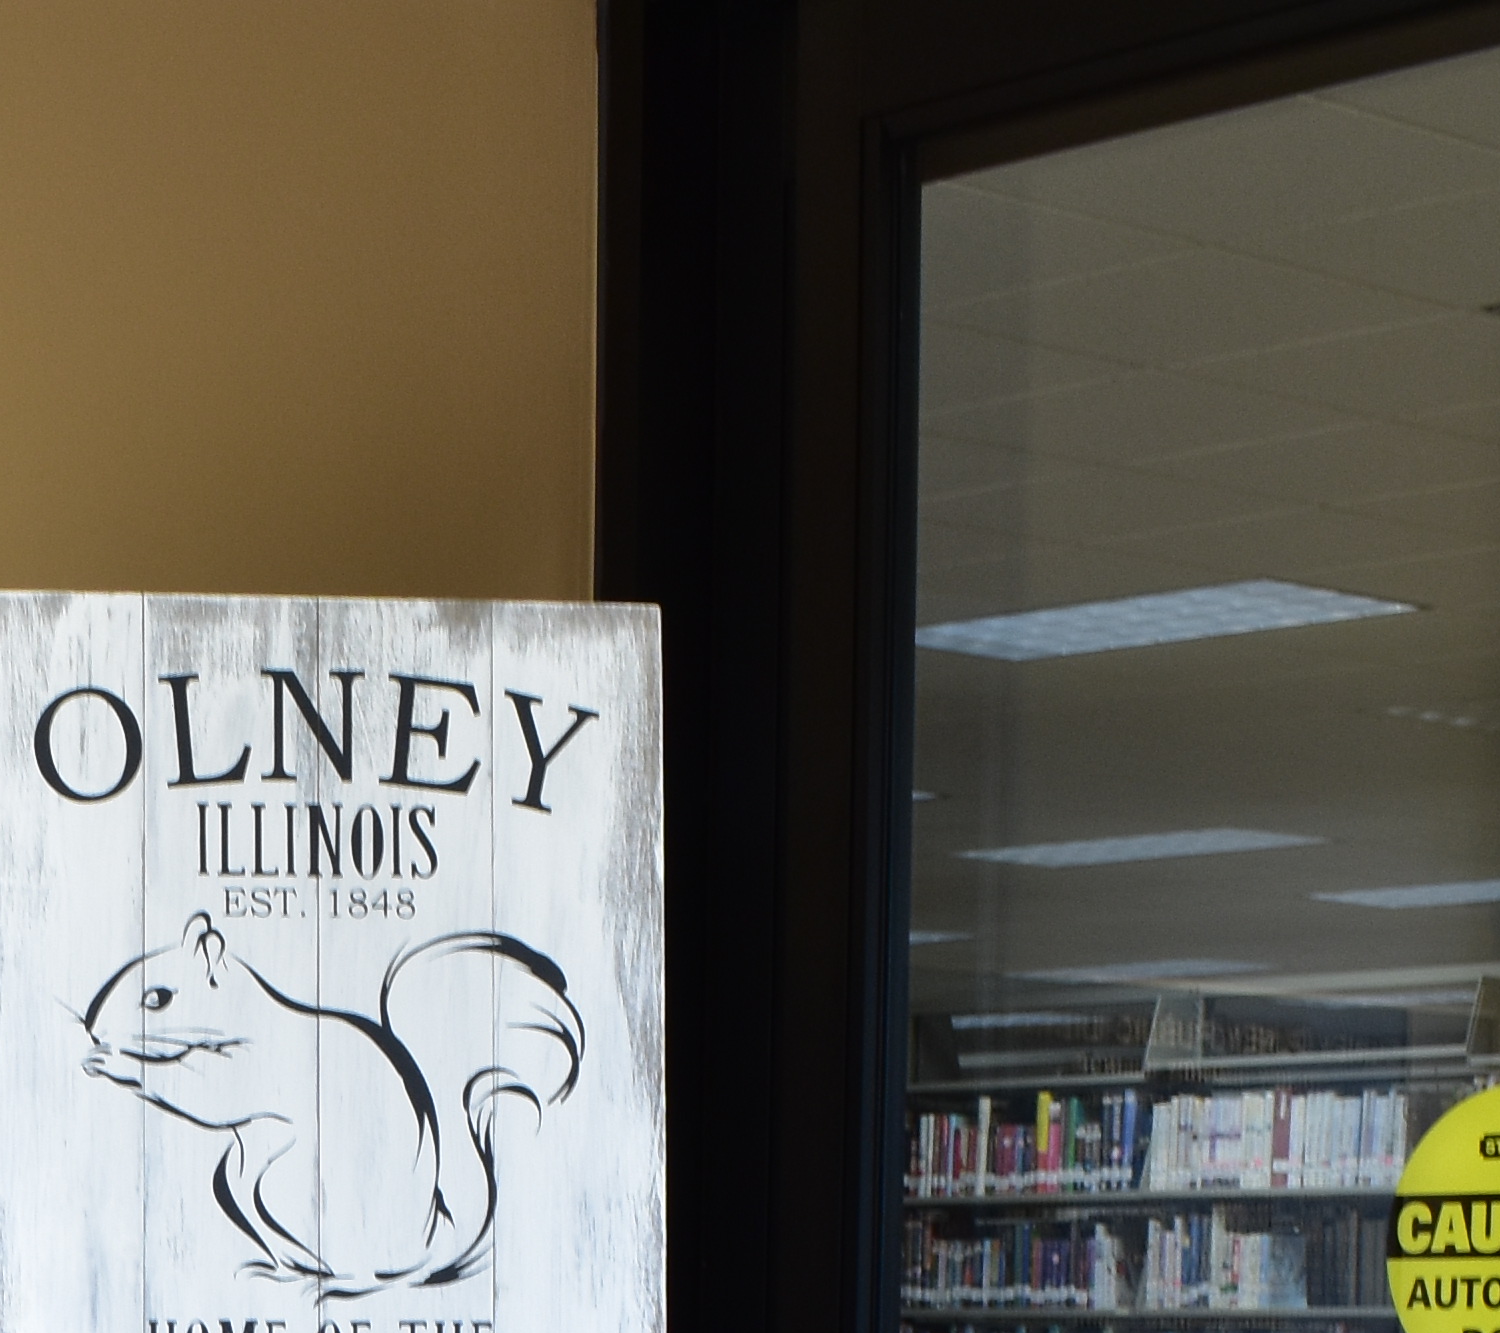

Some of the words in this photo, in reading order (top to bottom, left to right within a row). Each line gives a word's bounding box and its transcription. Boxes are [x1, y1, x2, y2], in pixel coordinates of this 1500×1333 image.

[34, 668, 600, 815] OLNEY
[196, 801, 440, 880] ILLINOIS
[223, 887, 308, 920] EST.
[329, 888, 418, 920] 1848
